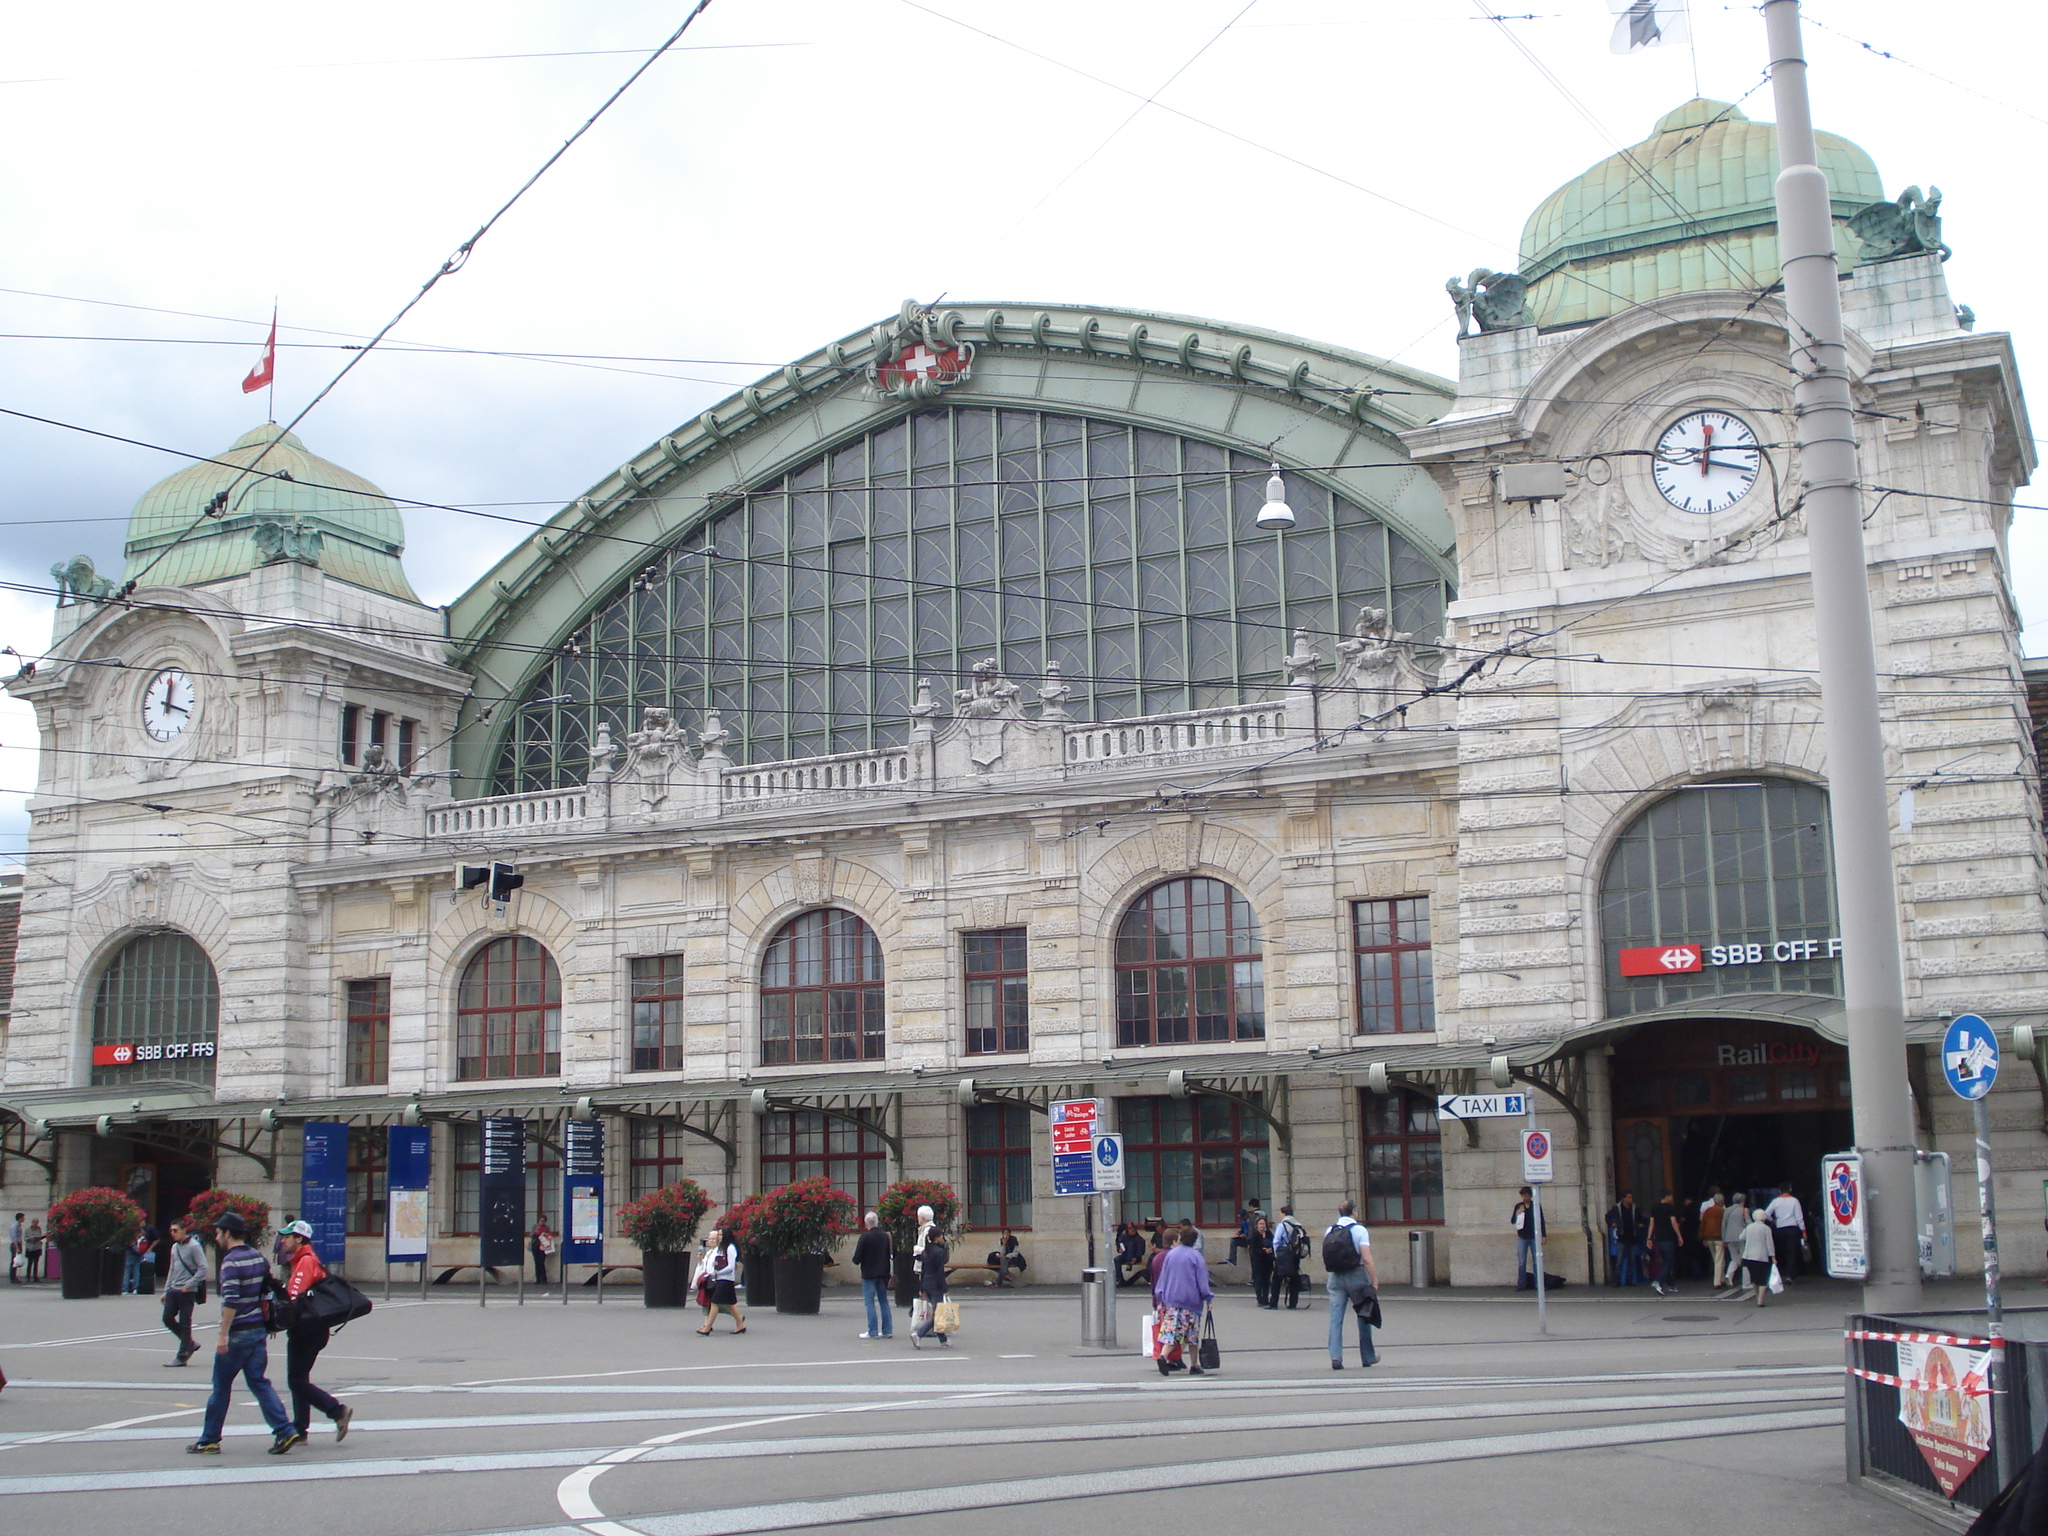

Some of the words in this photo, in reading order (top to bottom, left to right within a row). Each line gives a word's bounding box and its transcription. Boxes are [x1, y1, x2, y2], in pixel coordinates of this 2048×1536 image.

[1711, 943, 1763, 966] SBB
[1774, 939, 1819, 962] CFF
[1828, 937, 1841, 958] F
[136, 1045, 162, 1060] SBB
[166, 1043, 189, 1058] CFF
[192, 1041, 214, 1057] FFS
[1462, 1098, 1498, 1114] TAXI
[1967, 1449, 1977, 1462] Bar
[1933, 1456, 1945, 1470] Take
[1945, 1460, 1959, 1477] Away
[1940, 1476, 1954, 1491] Pizza
